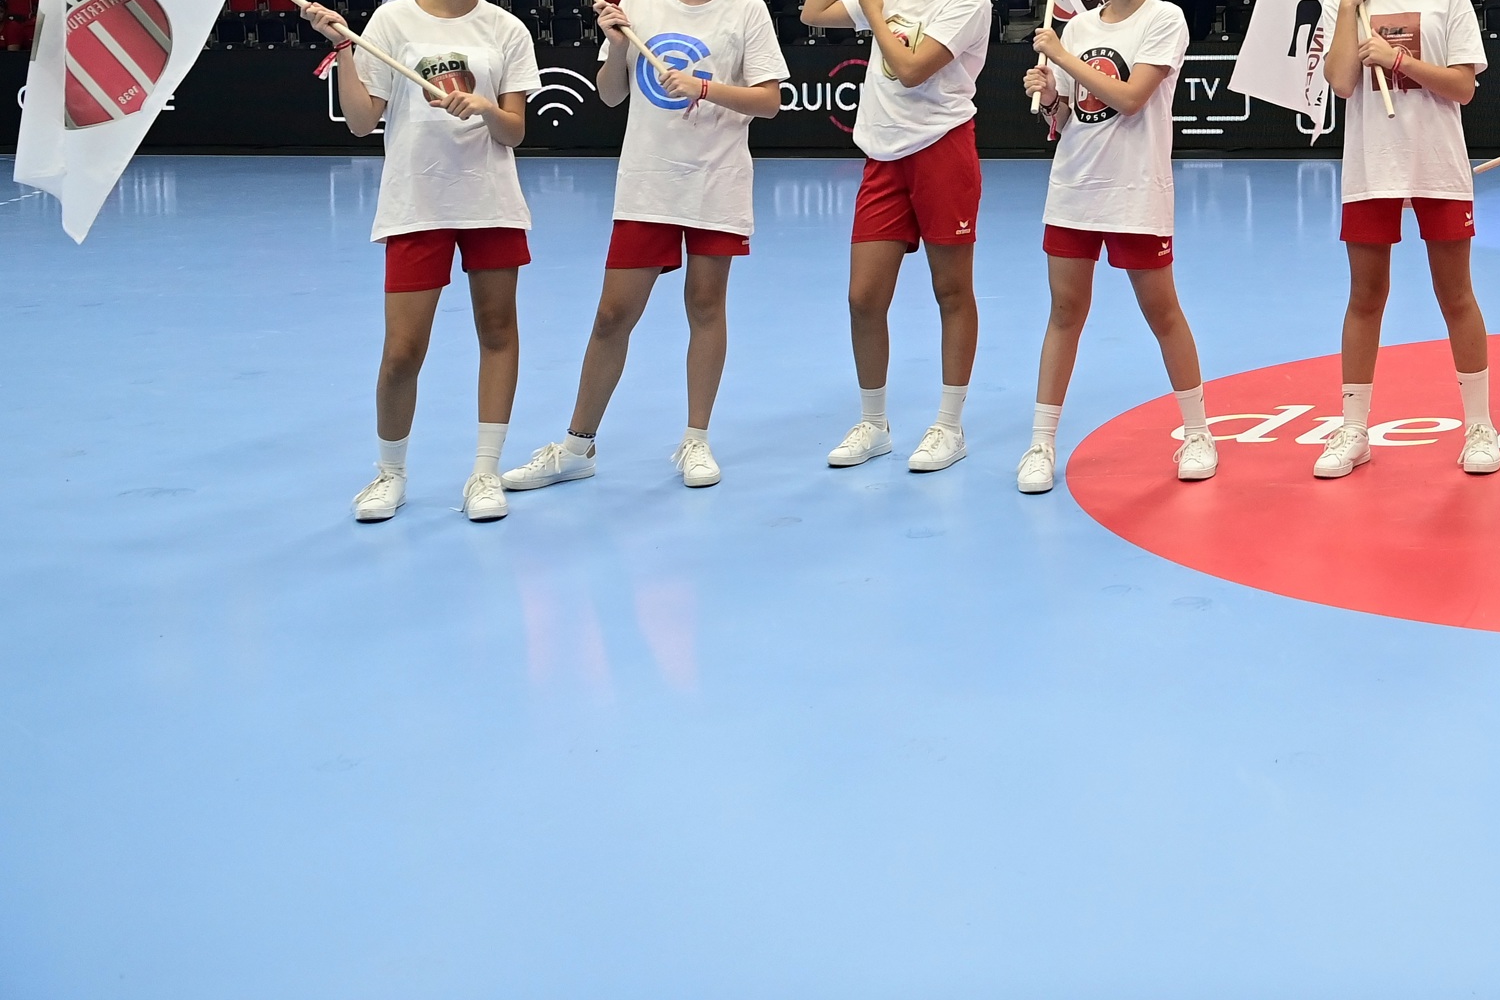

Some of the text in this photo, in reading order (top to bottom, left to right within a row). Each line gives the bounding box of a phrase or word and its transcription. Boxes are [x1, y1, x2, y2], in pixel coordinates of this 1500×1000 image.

[1083, 49, 1114, 61] BERN
[421, 60, 467, 80] PFADI
[1184, 77, 1221, 101] TV
[1080, 112, 1107, 121] 1959
